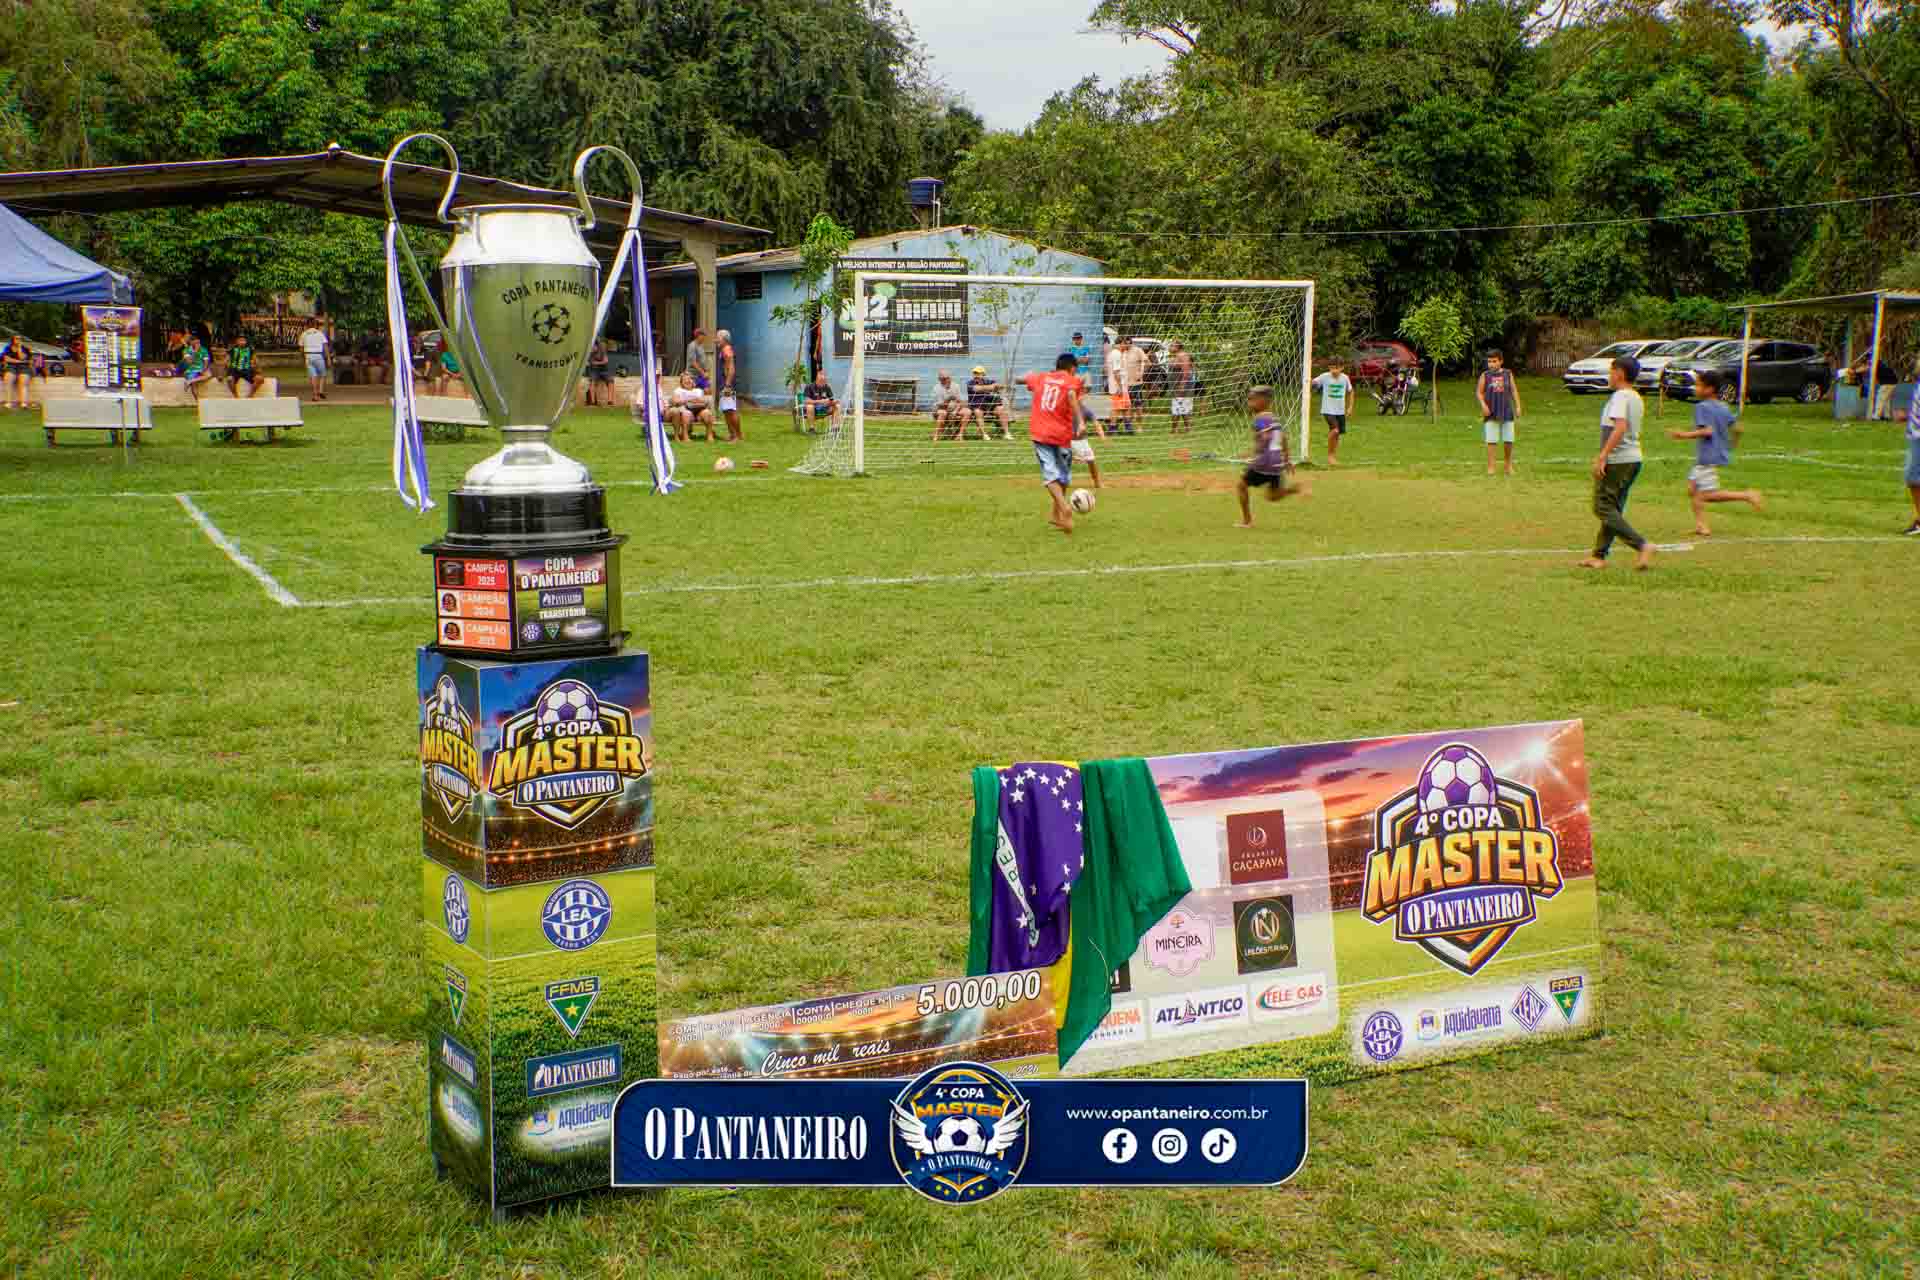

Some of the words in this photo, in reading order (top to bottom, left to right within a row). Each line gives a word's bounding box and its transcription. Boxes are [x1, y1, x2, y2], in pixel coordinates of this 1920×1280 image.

[844, 261, 867, 269] MELHOR
[868, 261, 896, 269] INTERNET
[897, 261, 907, 269] DA
[503, 284, 531, 305] COPA
[1041, 384, 1060, 412] 10
[545, 557, 575, 572] COPA
[521, 575, 529, 589] O
[531, 571, 600, 588] PANTANEIRO
[554, 720, 604, 737] COPA
[424, 729, 480, 788] MASTER
[491, 736, 642, 793] MASTER
[523, 783, 534, 801] O
[535, 775, 615, 800] PANTANEIRO
[1443, 807, 1505, 832] COPA
[1366, 830, 1560, 913] MASTER
[561, 907, 593, 924] LEA
[1407, 904, 1421, 934] O
[1423, 891, 1524, 931] PANTANEIRO
[1155, 935, 1203, 952] MINEIRA
[549, 980, 594, 998] FFMS
[917, 971, 1041, 1017] 5.000,00
[1552, 976, 1580, 990] FFMS
[797, 1004, 831, 1016] CONTA
[835, 998, 876, 1010] CHEQUE
[761, 1051, 808, 1077] Cinco
[813, 1044, 840, 1064] mil
[852, 1040, 891, 1058] reais
[544, 1066, 552, 1088] O
[553, 1057, 616, 1085] PANTANEIRO
